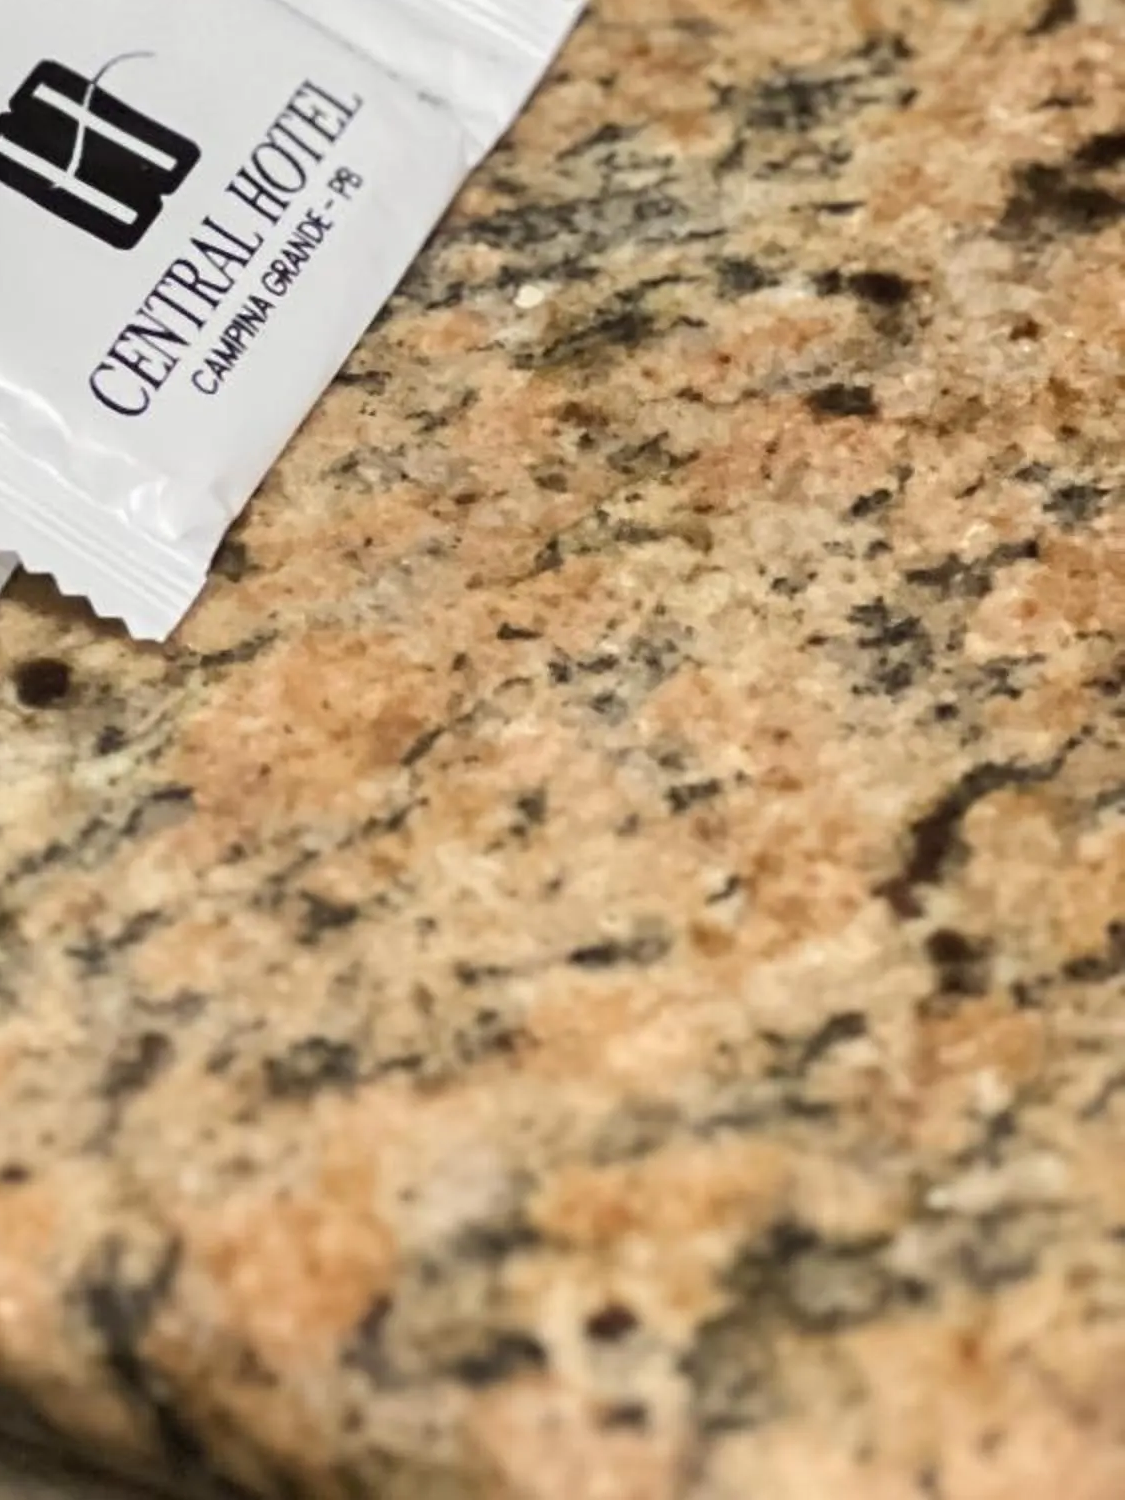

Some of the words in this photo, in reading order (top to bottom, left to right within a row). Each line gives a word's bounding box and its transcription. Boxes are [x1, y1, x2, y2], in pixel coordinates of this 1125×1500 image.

[88, 215, 265, 417] CENTRAL
[225, 78, 364, 226] HOTEL
[190, 294, 277, 396] CAMPINA
[260, 207, 334, 297] GRANDE
[328, 166, 364, 200] PB
